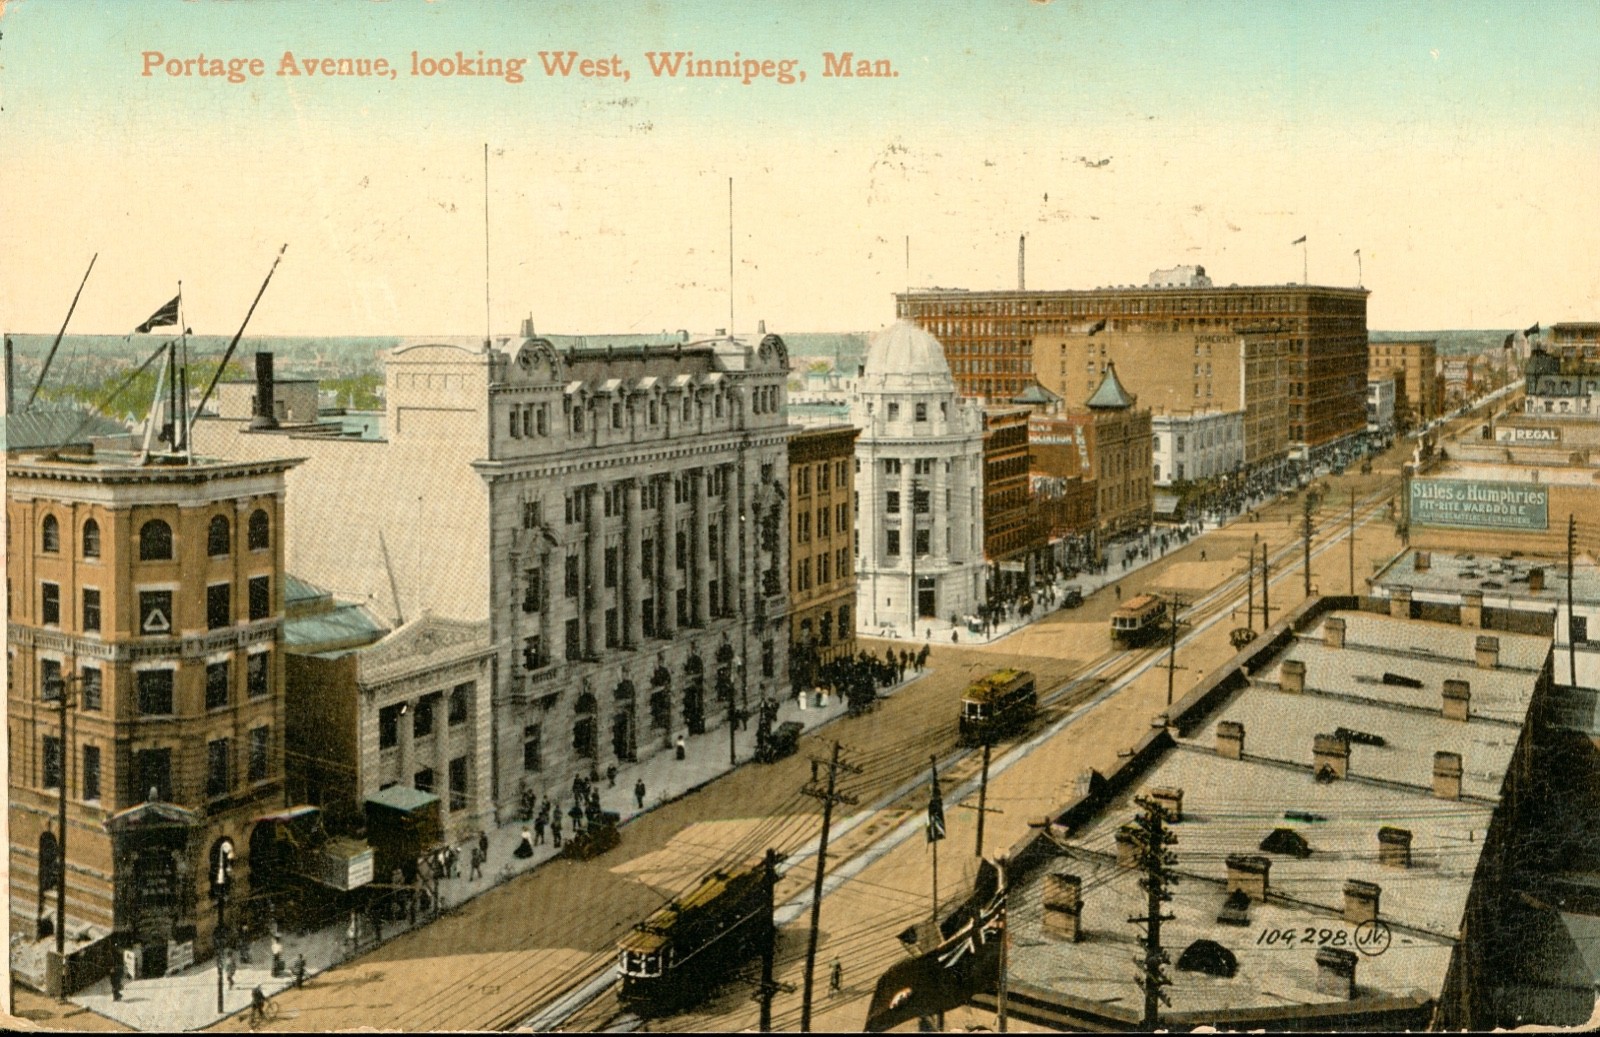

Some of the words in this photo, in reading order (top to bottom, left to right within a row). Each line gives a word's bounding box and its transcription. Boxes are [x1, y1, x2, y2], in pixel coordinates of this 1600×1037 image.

[1516, 429, 1559, 440] REGAL
[1413, 482, 1453, 500] Stiles
[1467, 484, 1545, 506] Humphries
[1420, 500, 1460, 511] FIT-RITE
[1462, 502, 1526, 515] WARDROBE
